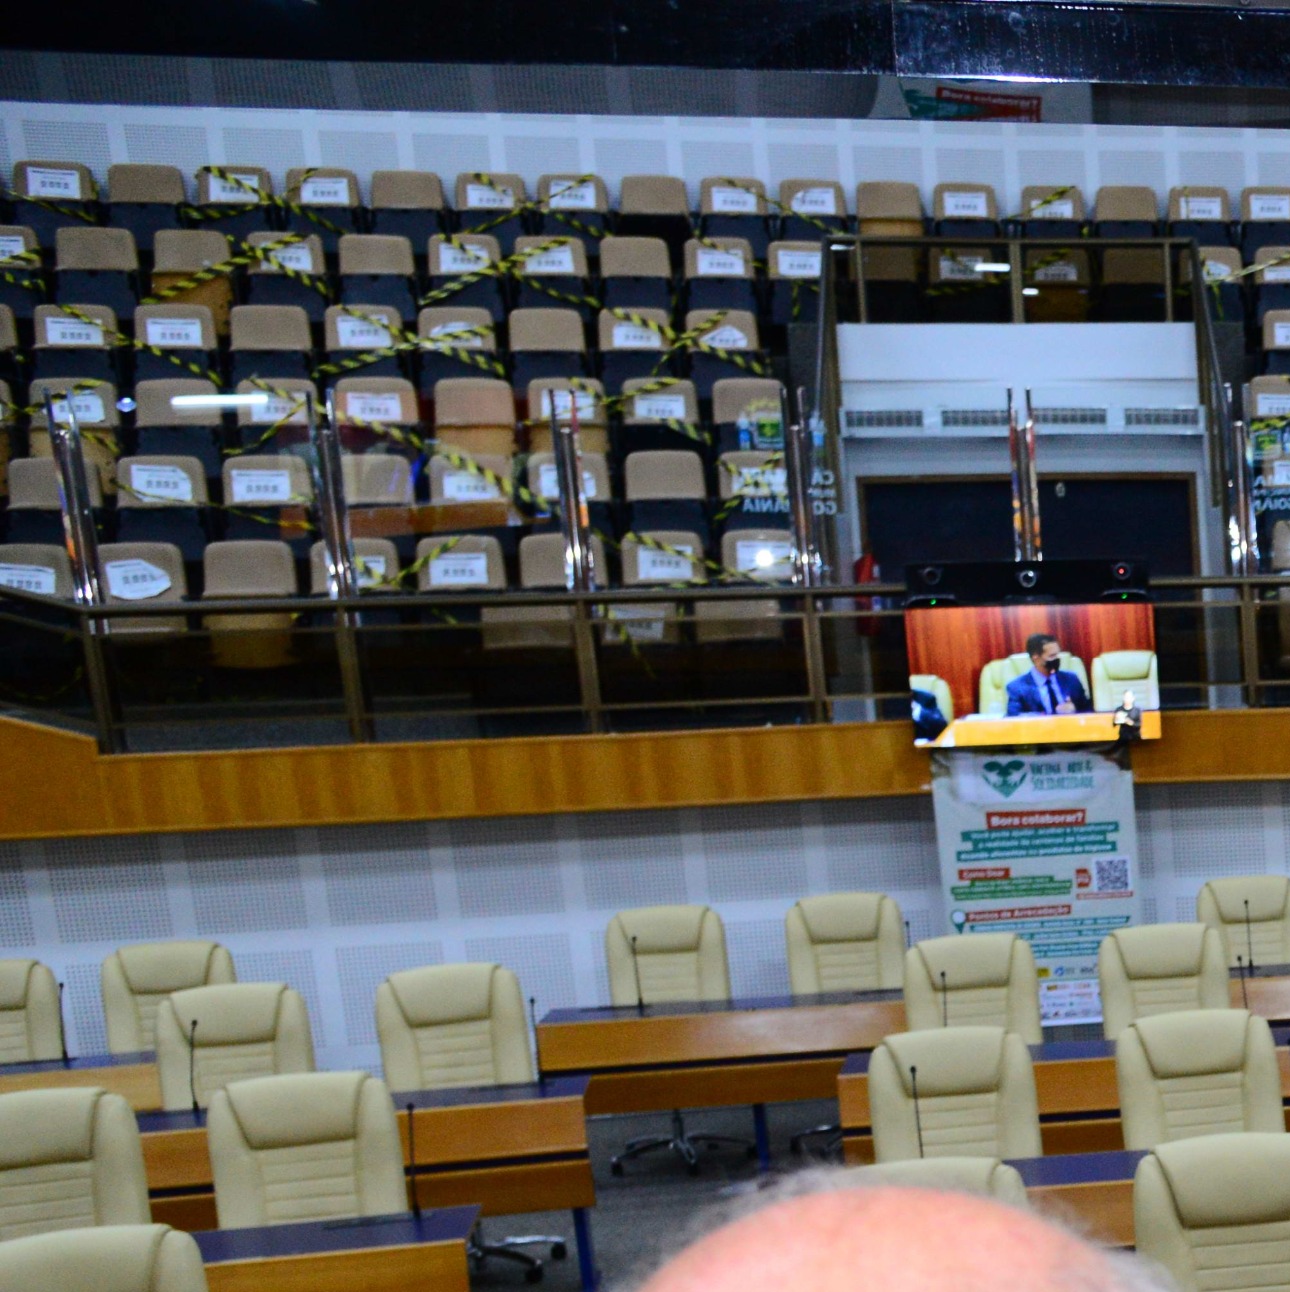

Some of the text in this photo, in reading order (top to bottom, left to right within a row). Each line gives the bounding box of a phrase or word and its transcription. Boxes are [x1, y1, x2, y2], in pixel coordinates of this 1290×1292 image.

[991, 811, 1084, 826] Bora colaborar?
[1014, 905, 1069, 917] Arrecadação
